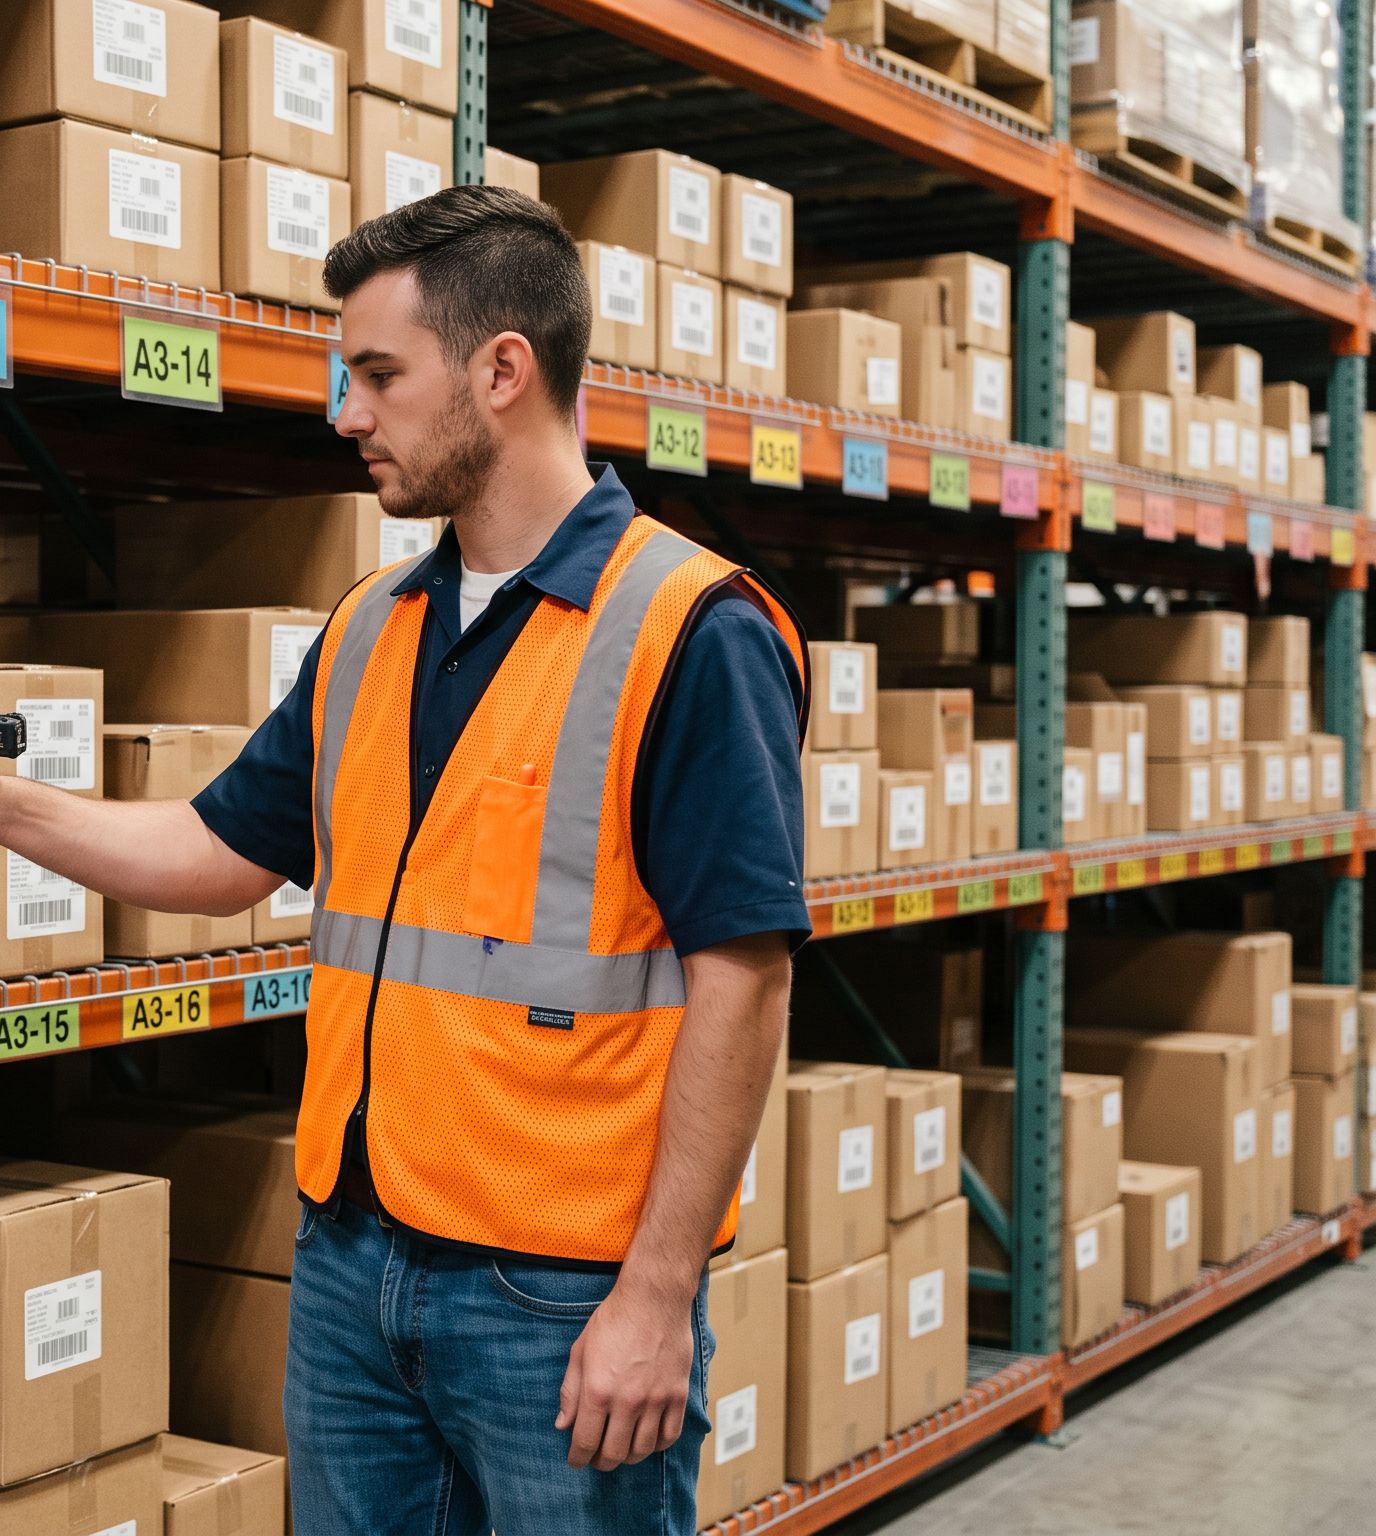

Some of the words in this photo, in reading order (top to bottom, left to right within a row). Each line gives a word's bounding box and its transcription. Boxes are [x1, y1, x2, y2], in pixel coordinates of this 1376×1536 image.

[132, 338, 212, 388] A3-14
[654, 421, 700, 458] A3-12
[131, 989, 201, 1031] A3-16
